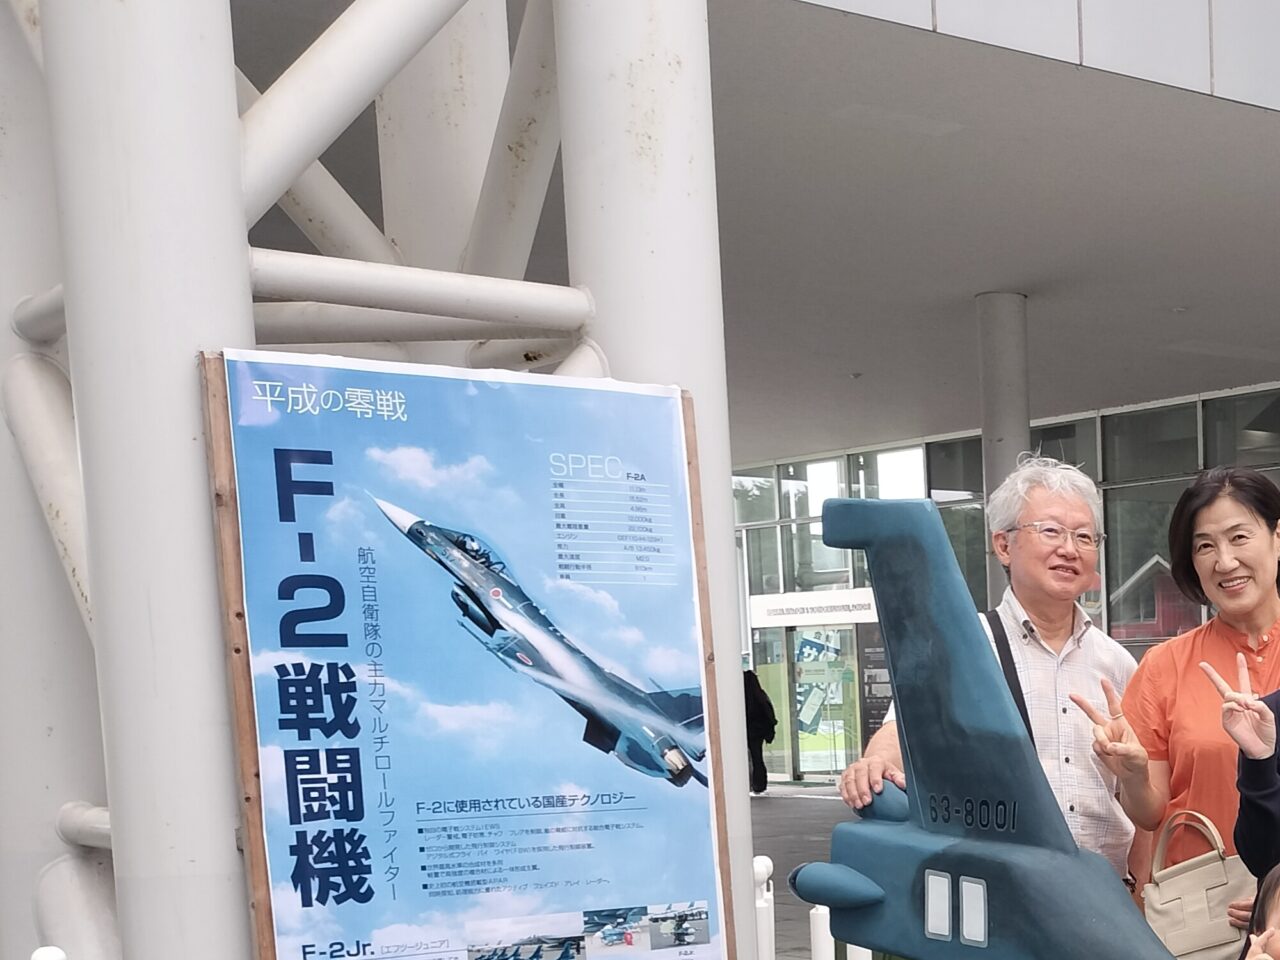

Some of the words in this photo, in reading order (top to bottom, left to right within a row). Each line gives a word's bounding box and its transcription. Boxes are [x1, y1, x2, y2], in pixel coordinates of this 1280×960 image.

[252, 380, 407, 422] 平成の零戦
[549, 452, 622, 479] SPEC
[626, 472, 647, 482] F-2A
[273, 448, 375, 908] F-2戦闘機
[358, 546, 400, 901] 航空自衛隊の主力マルチロールファイター
[416, 792, 636, 815] F-2に使用されている国産テクノロジー
[929, 793, 1018, 832] 63-8001
